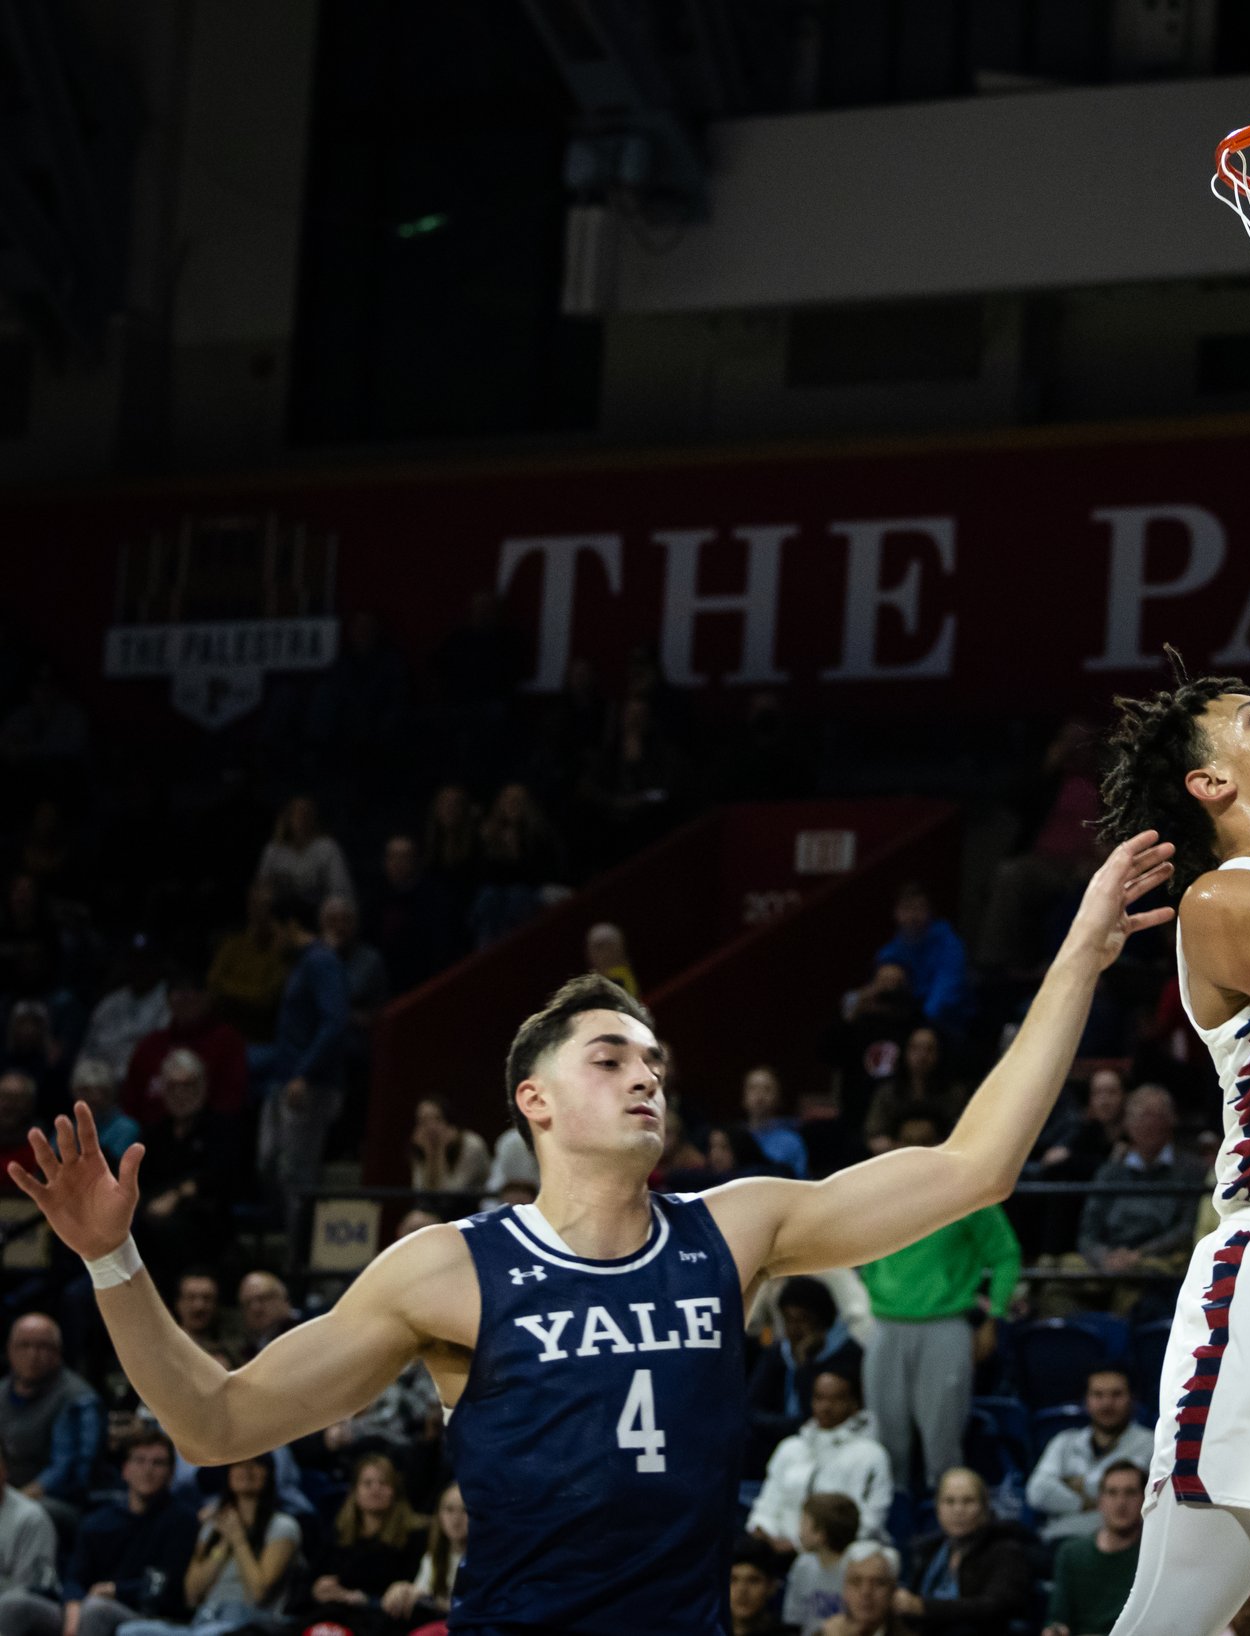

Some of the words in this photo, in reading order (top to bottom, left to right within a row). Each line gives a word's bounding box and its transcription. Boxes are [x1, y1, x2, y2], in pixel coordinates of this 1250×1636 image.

[497, 515, 959, 696] THE
[119, 632, 165, 666] THE
[181, 627, 322, 665] PALESTRA
[325, 1219, 369, 1247] 104
[514, 1297, 722, 1362] YALE
[616, 1368, 666, 1473] 4
